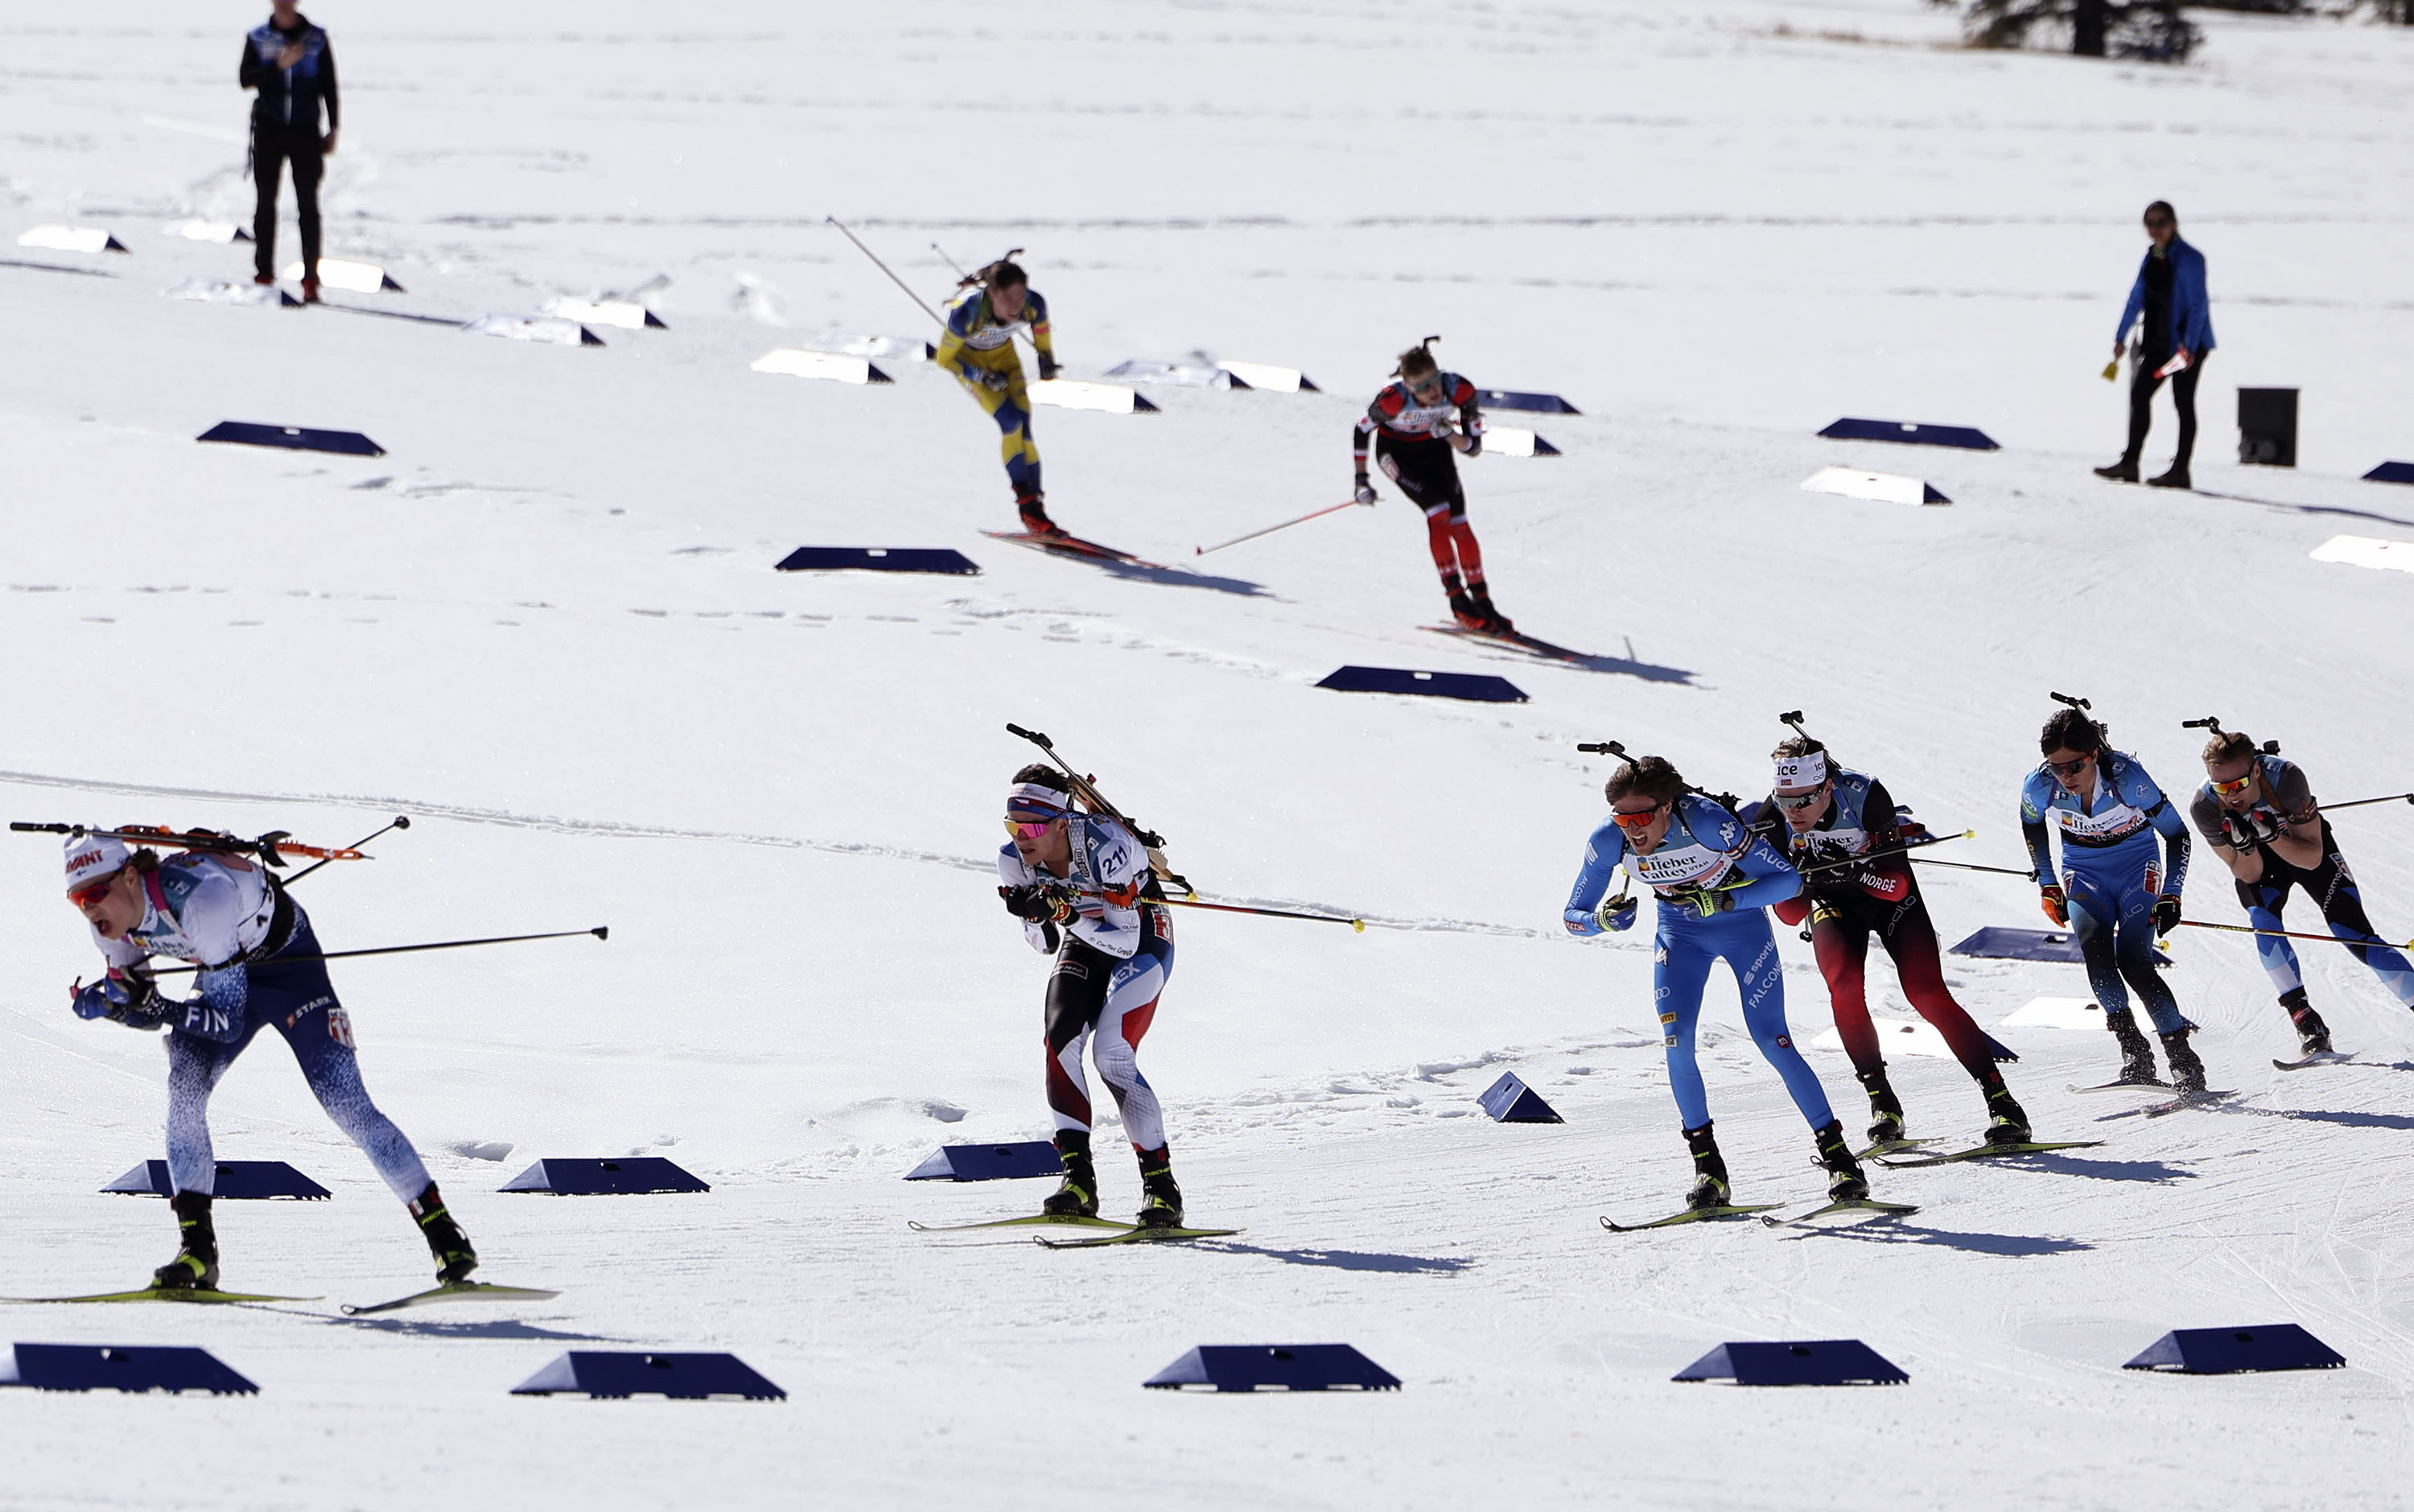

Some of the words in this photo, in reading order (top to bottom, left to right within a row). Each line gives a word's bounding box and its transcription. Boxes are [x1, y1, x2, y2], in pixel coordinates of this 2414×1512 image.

[1777, 760, 1798, 776] ice
[1102, 845, 1127, 875] 211
[1640, 867, 1687, 880] Valley
[1689, 861, 1709, 871] UTAH
[1650, 855, 1697, 870] Heber
[1755, 847, 1792, 872] Audi
[2173, 838, 2189, 886] FRANCE
[1859, 871, 1897, 893] NORGE
[295, 995, 332, 1019] STARK
[185, 1006, 229, 1032] FIN
[1048, 1216, 1080, 1224] FISCHER
